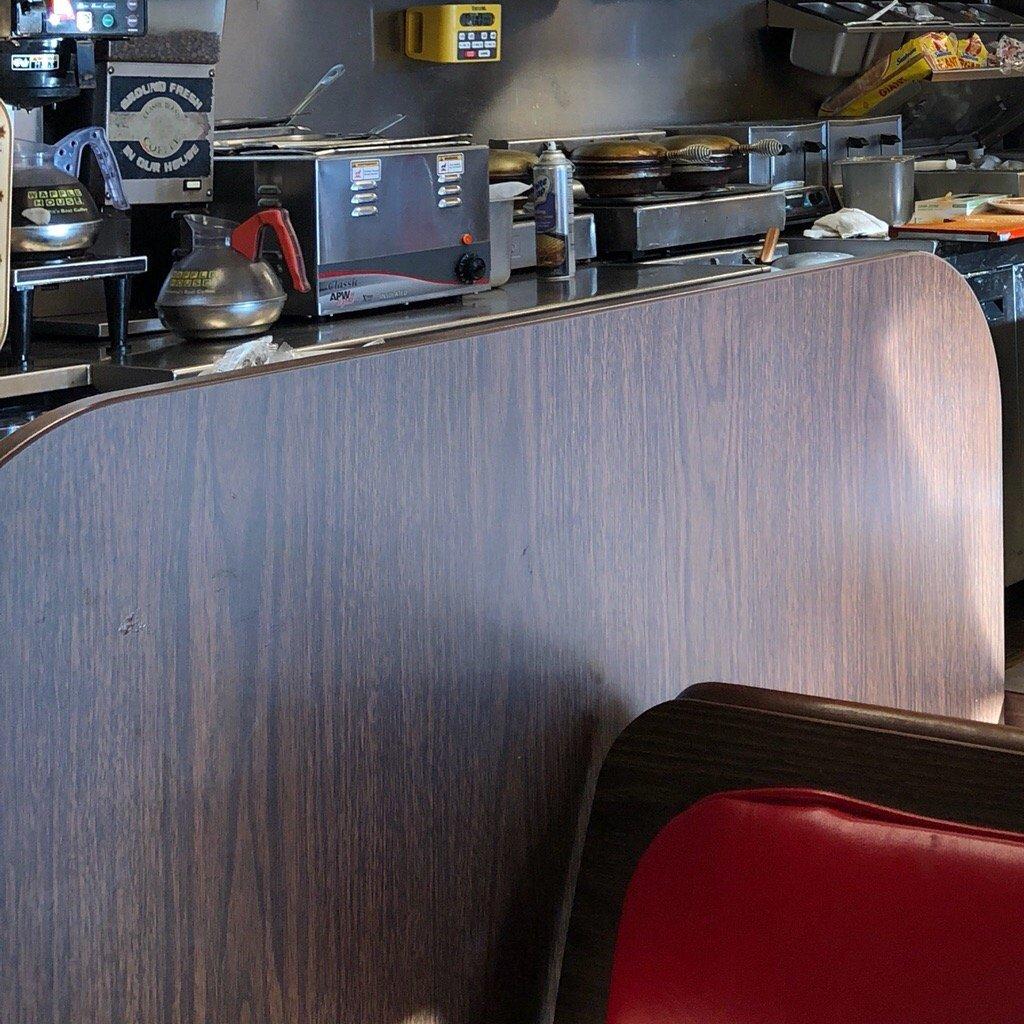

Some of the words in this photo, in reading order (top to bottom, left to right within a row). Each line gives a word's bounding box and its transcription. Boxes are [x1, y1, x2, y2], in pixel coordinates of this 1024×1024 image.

[120, 80, 167, 111] GROUND
[169, 82, 204, 111] FRESH
[122, 144, 137, 161] IN
[136, 156, 161, 173] OUR
[163, 143, 200, 173] HOUSE
[28, 189, 82, 199] WAFFLE
[34, 197, 83, 207] HOUSE
[329, 290, 351, 302] APW
